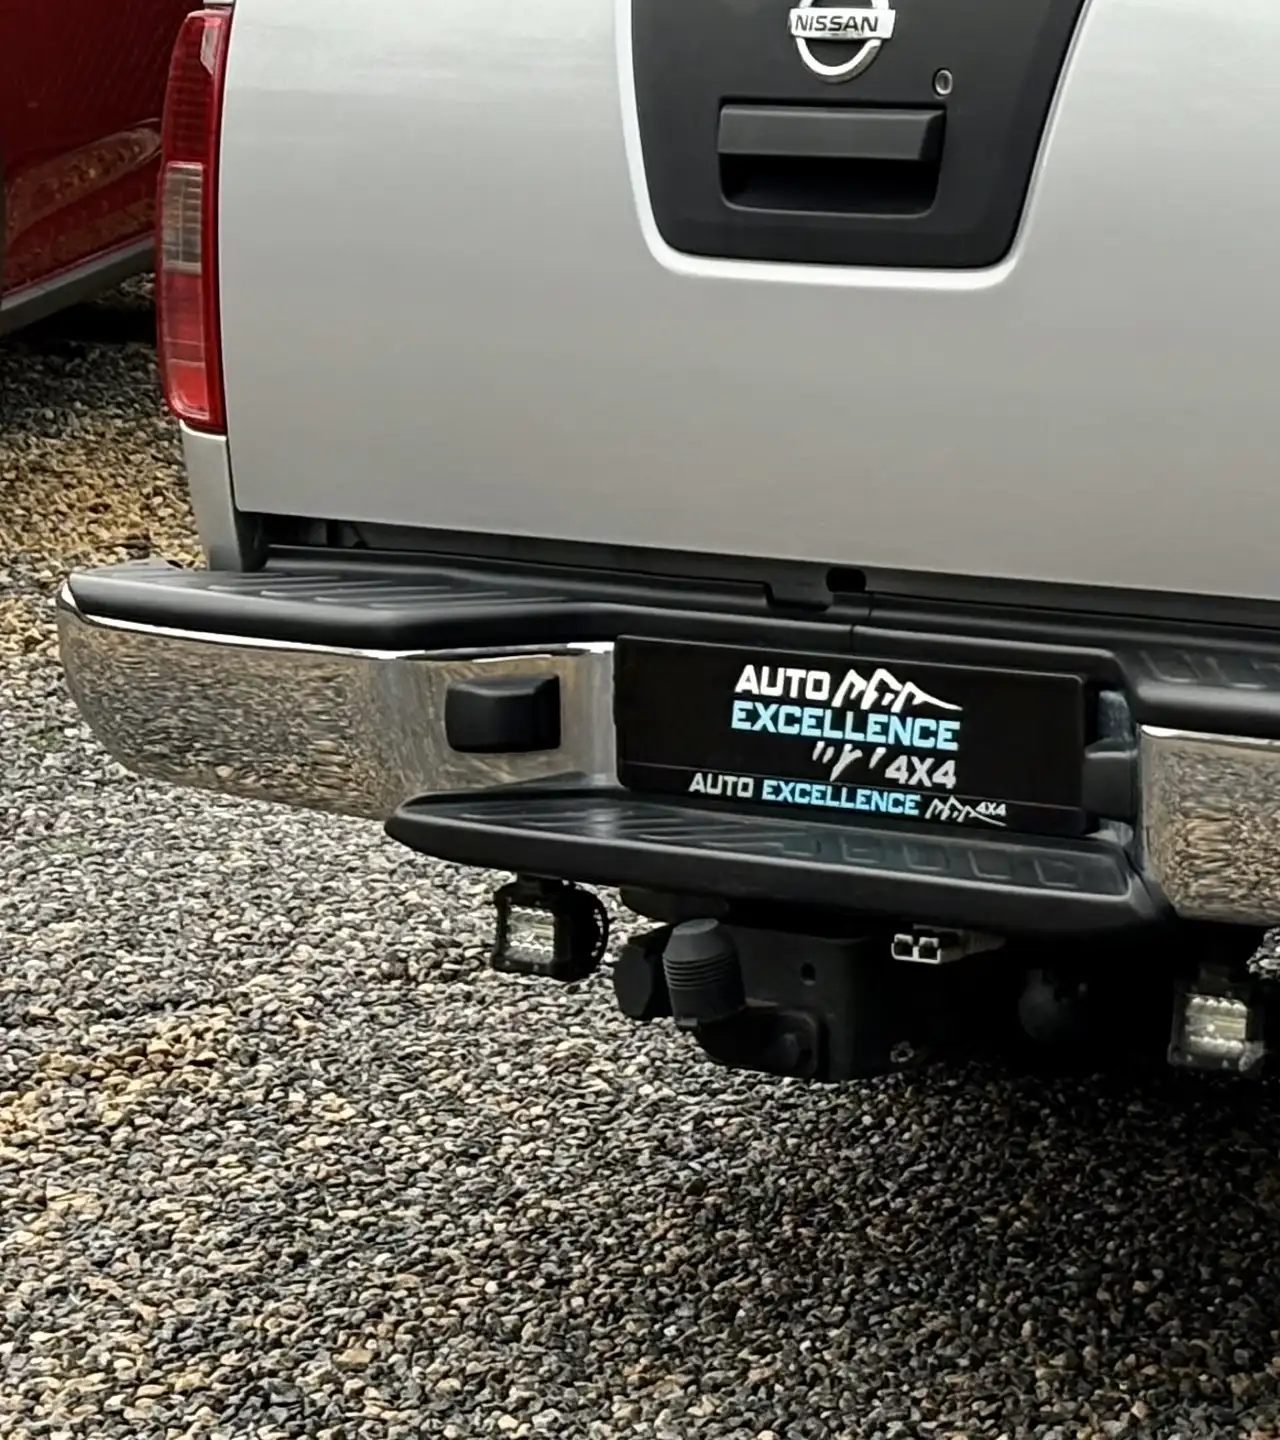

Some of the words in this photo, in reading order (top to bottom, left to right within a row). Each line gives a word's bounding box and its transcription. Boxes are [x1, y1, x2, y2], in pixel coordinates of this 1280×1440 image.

[796, 15, 879, 32] NISSAN
[735, 664, 832, 701] AUTO
[731, 700, 961, 752] EXCELLENCE
[886, 756, 957, 789] 4X4
[688, 773, 755, 798] AUTO
[761, 779, 922, 817] EXCELLENCE
